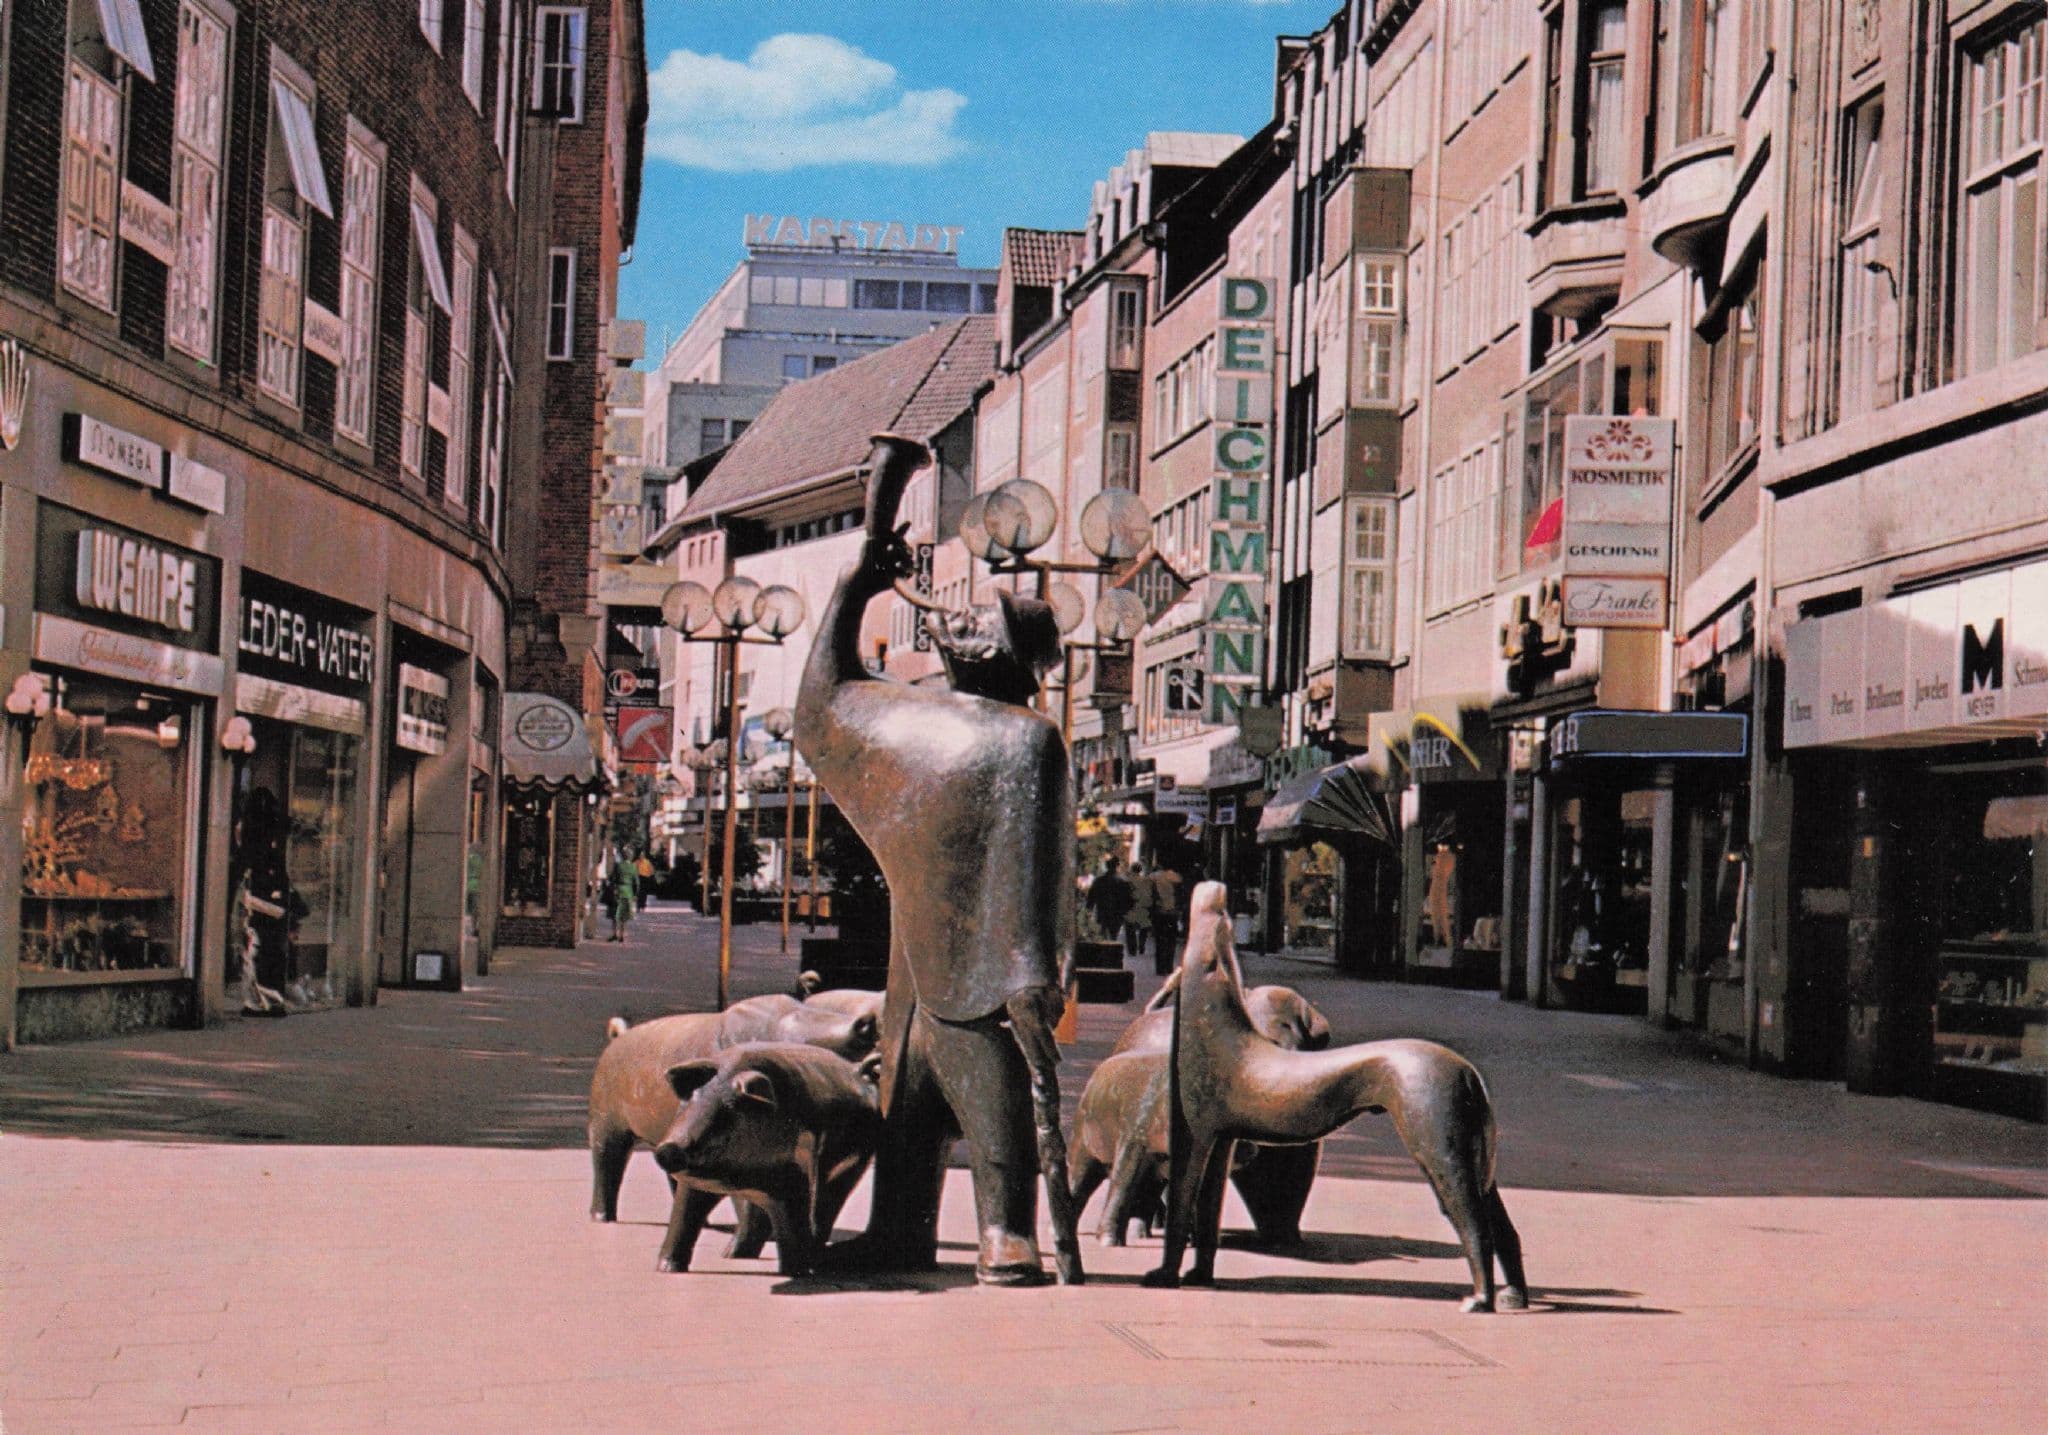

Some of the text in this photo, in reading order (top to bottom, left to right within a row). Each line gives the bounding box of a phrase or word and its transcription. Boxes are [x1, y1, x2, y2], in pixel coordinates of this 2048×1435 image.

[744, 213, 964, 253] KARSTADT
[107, 434, 152, 472] OMEGA
[1570, 469, 1665, 486] KOSMETIK
[1209, 278, 1268, 722] DEICHMANN
[1569, 545, 1660, 557] GESCHENKE
[80, 528, 197, 633] WEMPE
[1568, 582, 1659, 611] Franke
[238, 597, 373, 684] LEDER-VATER
[1961, 617, 2004, 695] M
